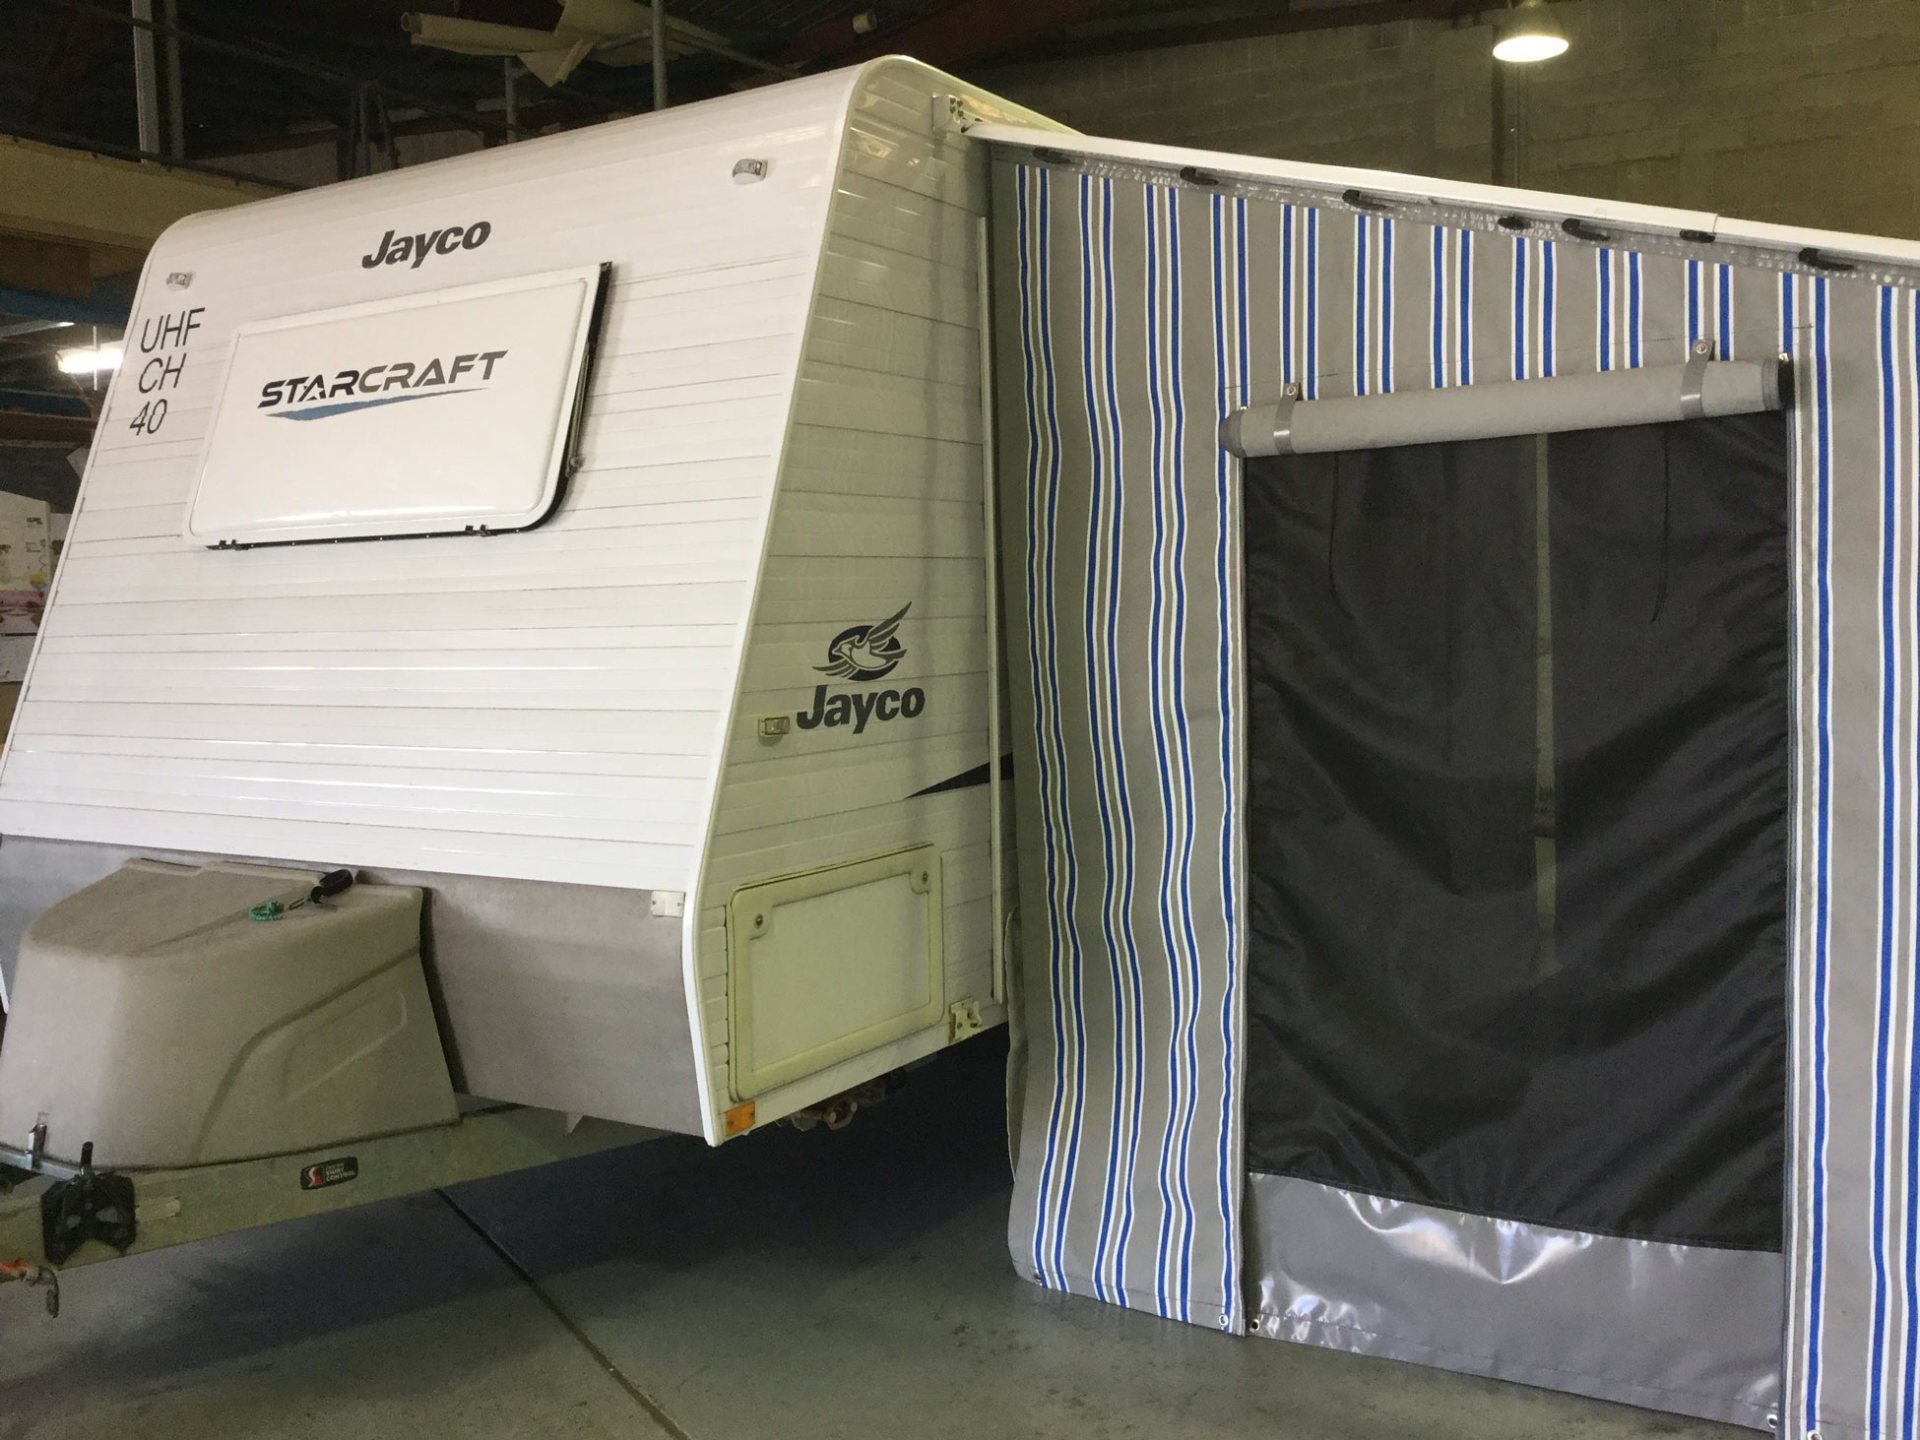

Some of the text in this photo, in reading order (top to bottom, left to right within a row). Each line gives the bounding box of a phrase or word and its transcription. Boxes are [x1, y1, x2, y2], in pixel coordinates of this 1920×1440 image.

[361, 221, 491, 270] Jayco
[141, 307, 205, 353] UHF
[138, 353, 187, 394] CH
[258, 351, 507, 408] STARCRAFT
[130, 398, 168, 435] 40
[796, 684, 926, 735] Jayco
